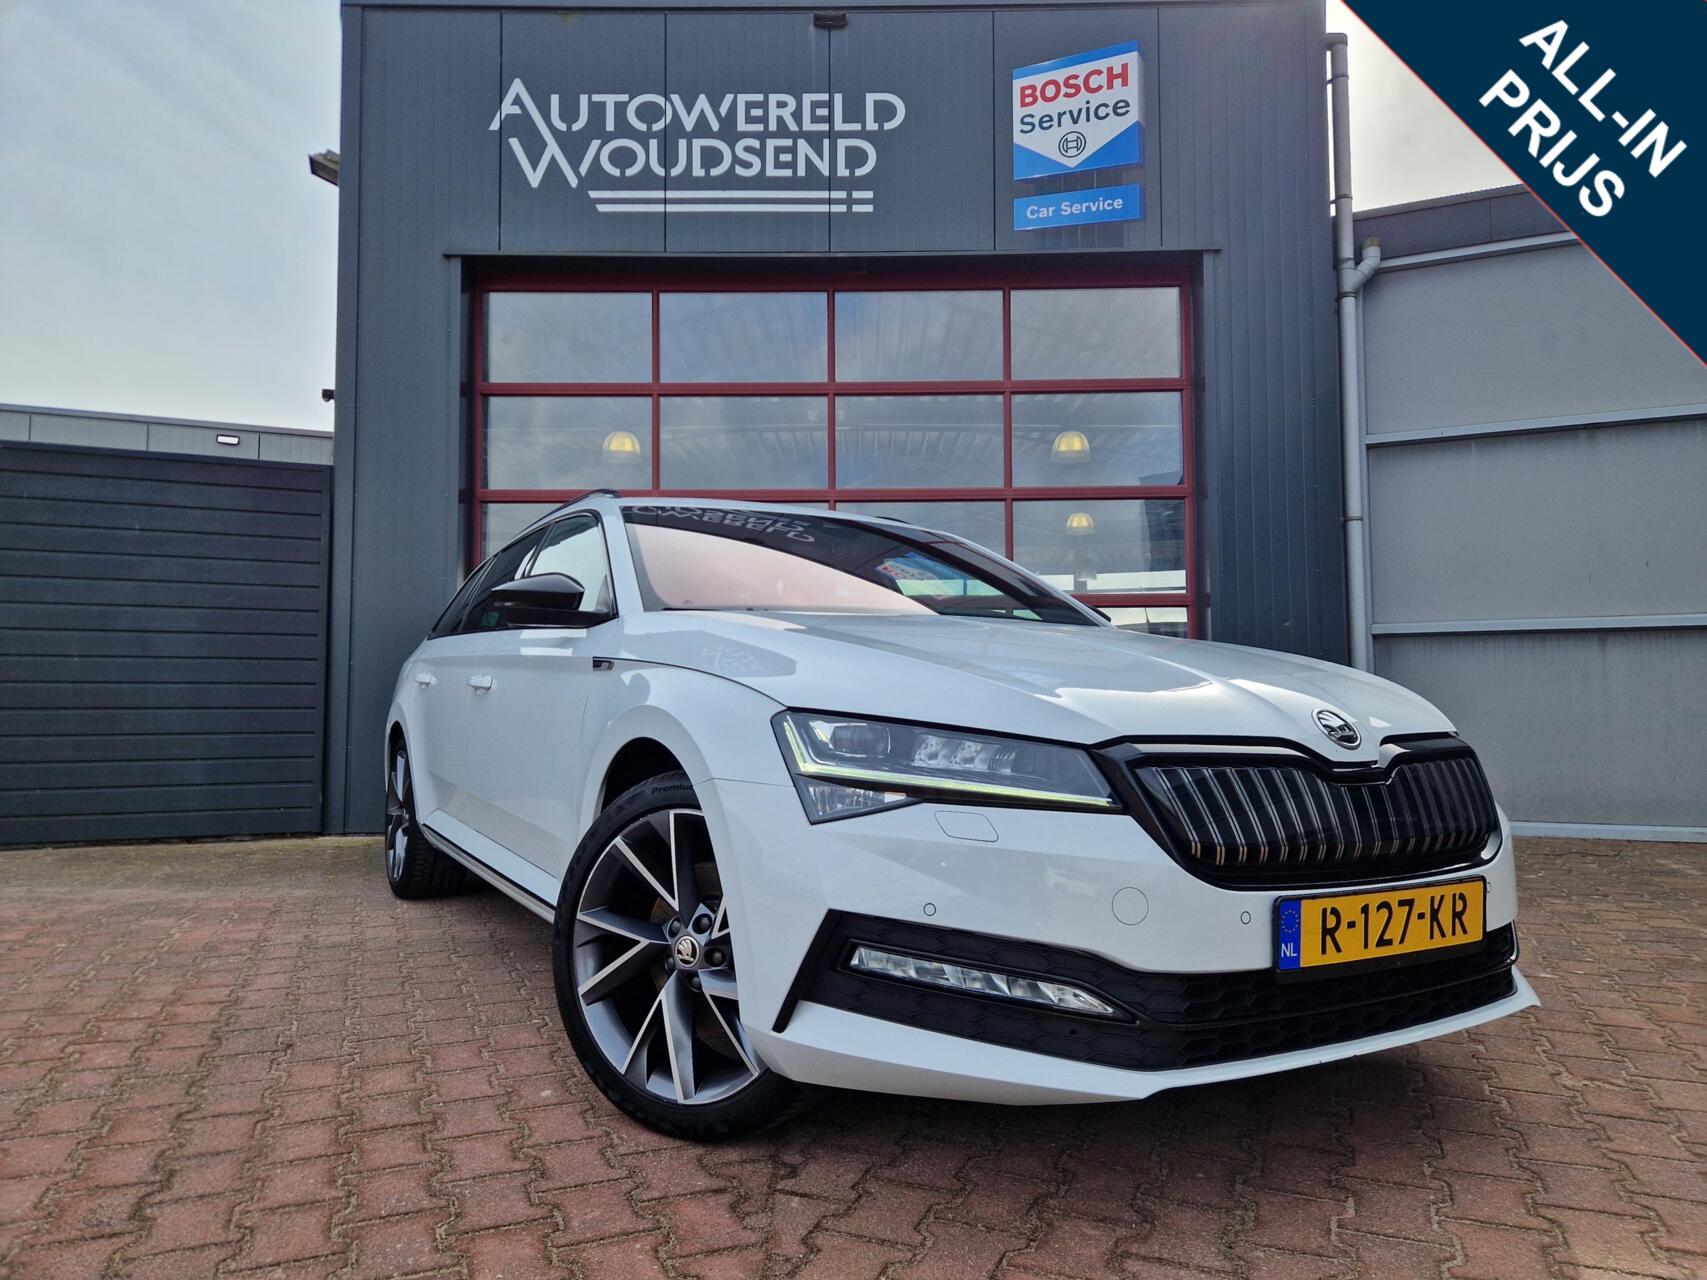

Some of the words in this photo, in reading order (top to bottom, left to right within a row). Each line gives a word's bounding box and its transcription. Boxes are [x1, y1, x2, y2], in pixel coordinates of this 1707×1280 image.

[488, 77, 906, 132] AUTOWERELD
[1019, 62, 1129, 108] BOSCH
[1019, 98, 1130, 134] Service
[508, 137, 877, 188] WOUDSEND
[1026, 205, 1056, 219] Car
[1060, 197, 1123, 215] Service
[1321, 892, 1468, 955] R-127-KR
[1281, 942, 1298, 957] NL
